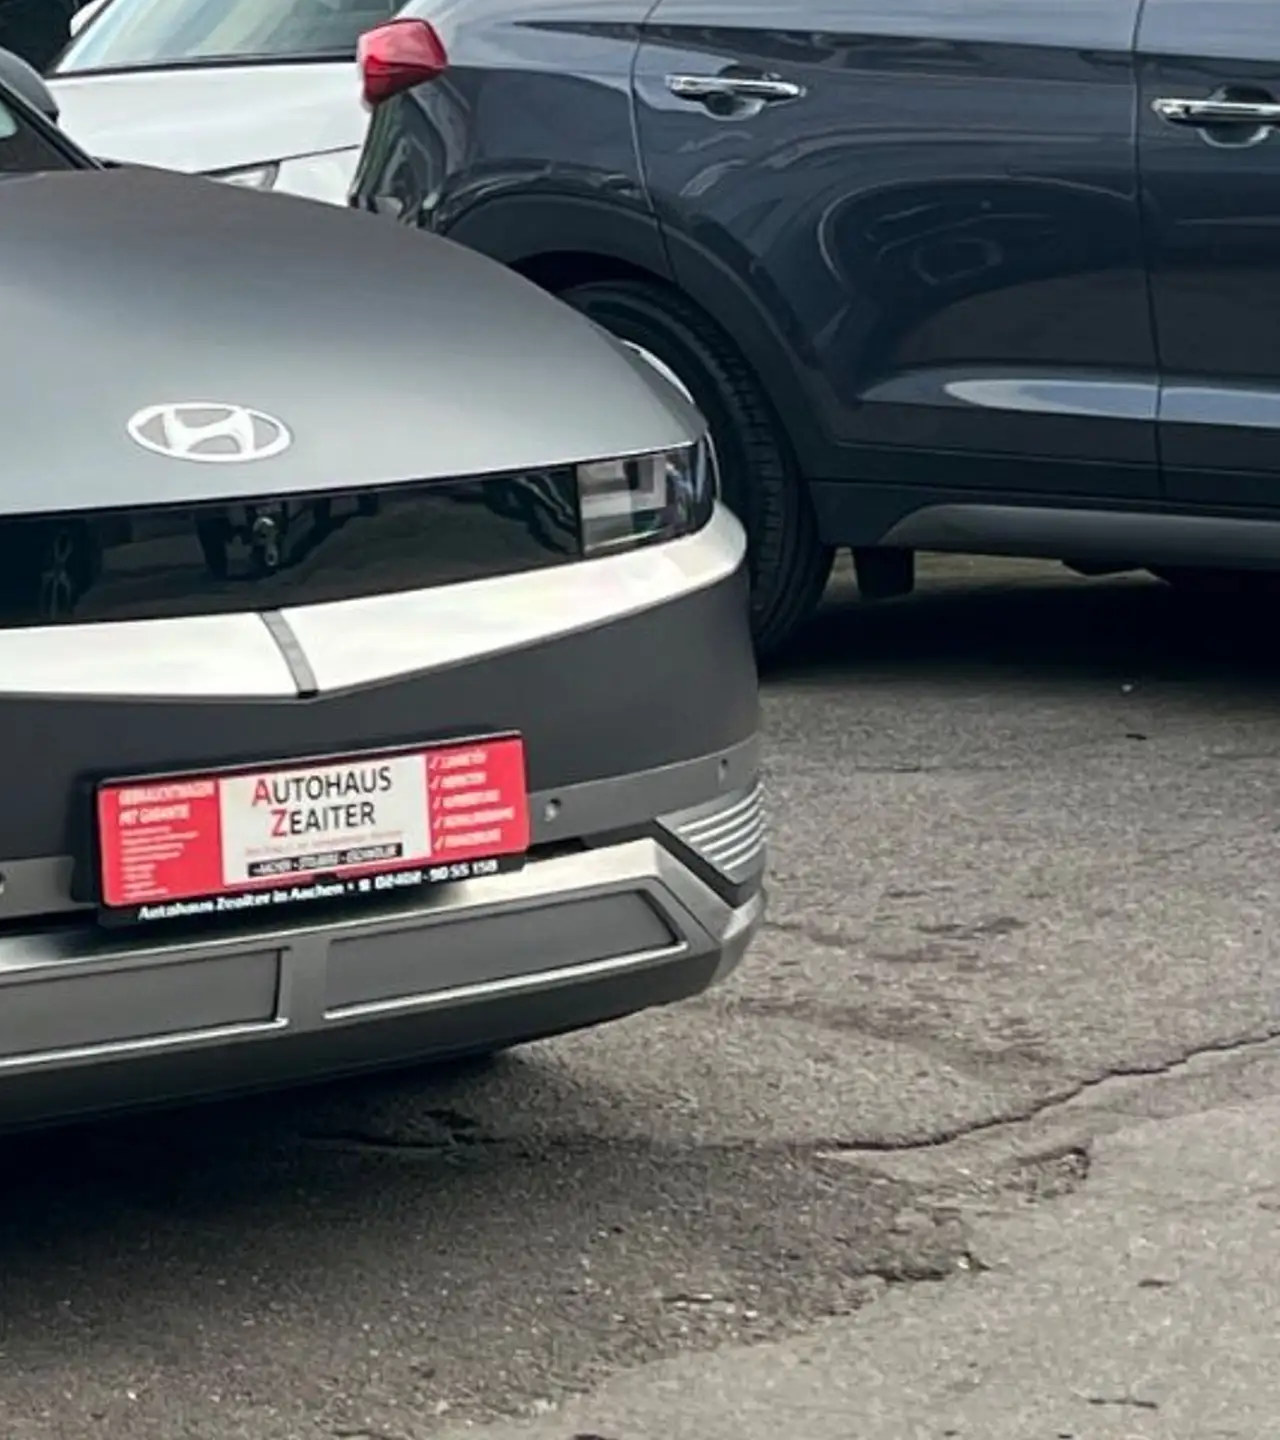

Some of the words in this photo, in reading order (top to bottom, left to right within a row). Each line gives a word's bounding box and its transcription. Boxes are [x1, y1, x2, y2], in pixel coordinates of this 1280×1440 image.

[252, 766, 392, 806] AUTOHAUS
[271, 801, 376, 838] ZEAITER
[138, 900, 214, 920] Autohaus
[216, 892, 270, 911] Zeaiter
[272, 889, 288, 903] in
[289, 883, 344, 901] Aachen
